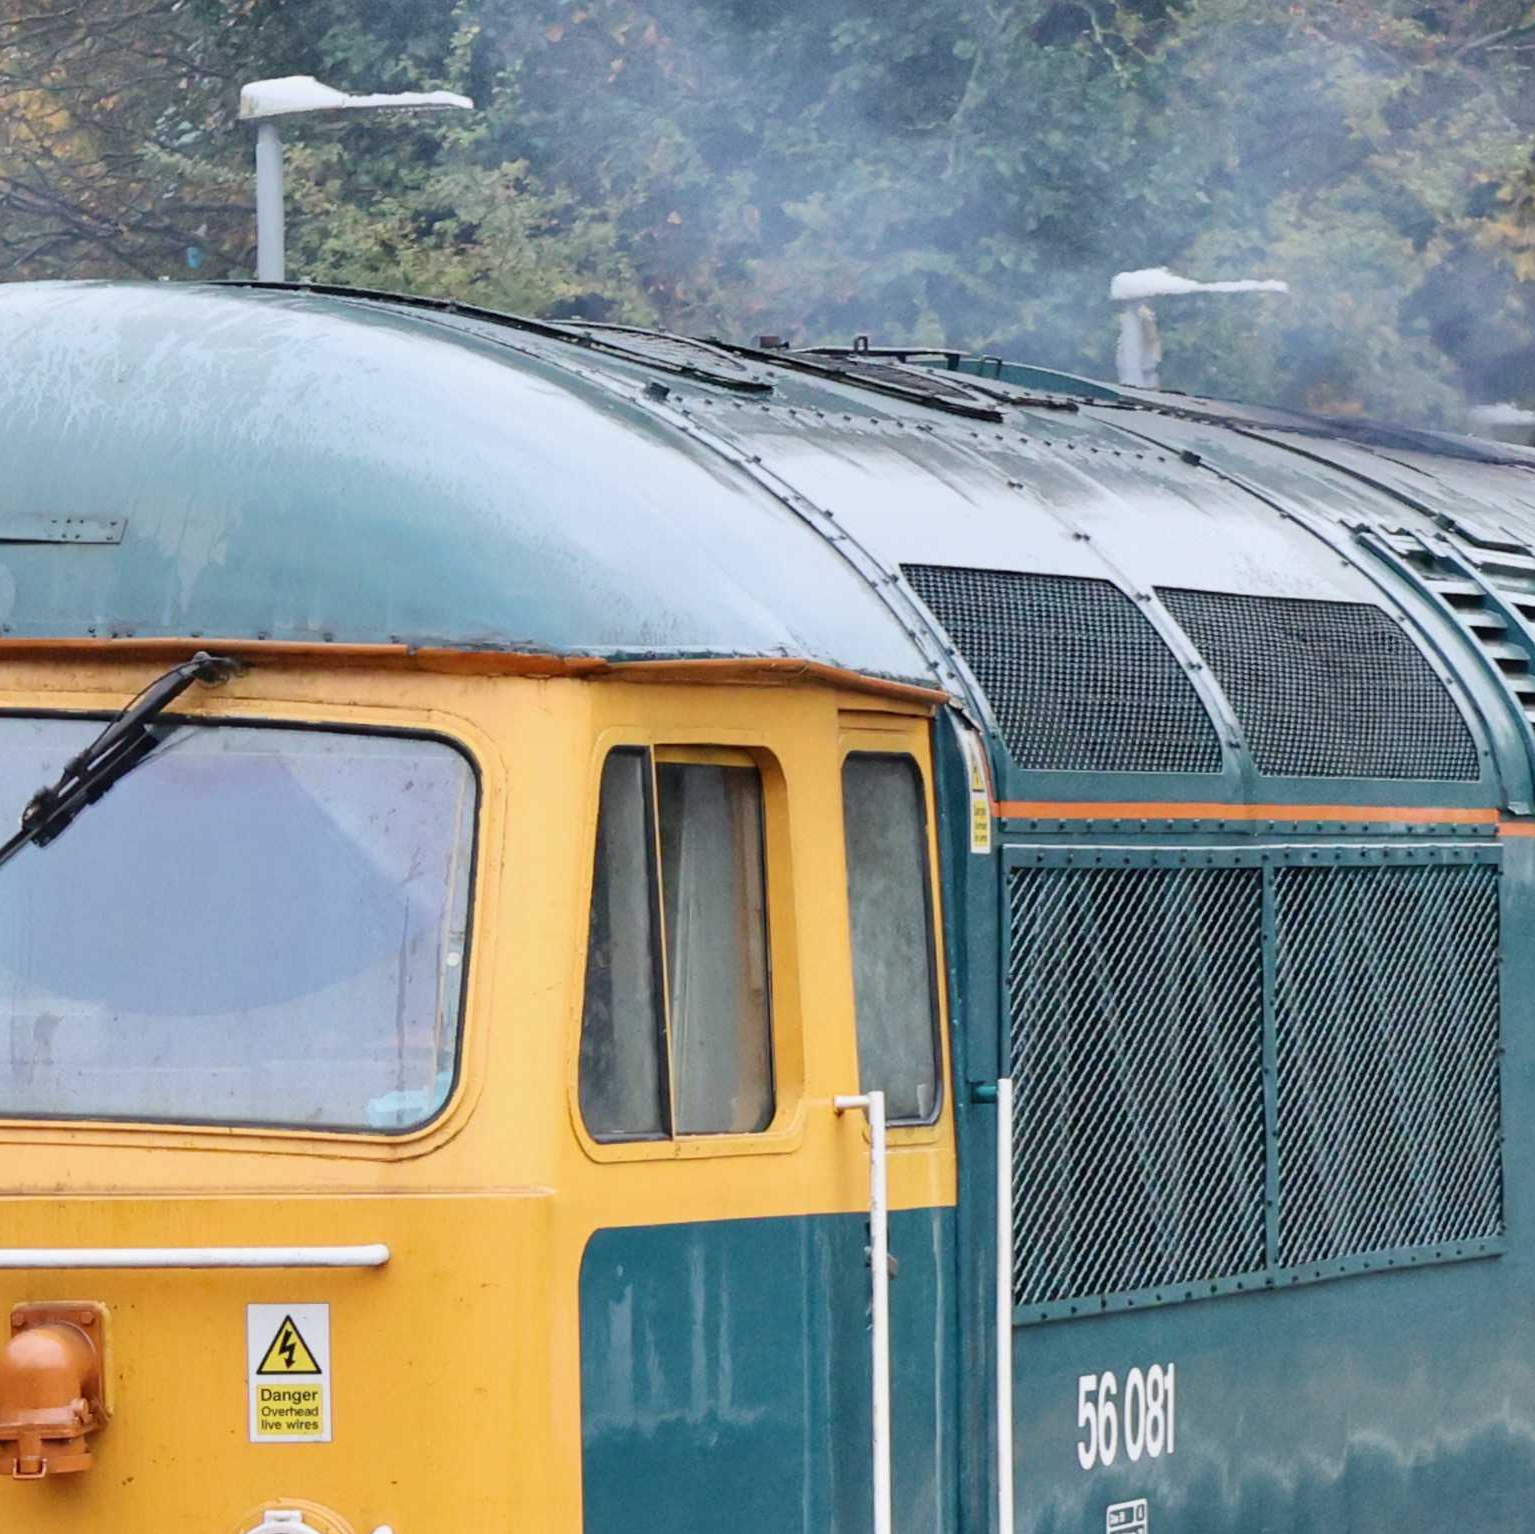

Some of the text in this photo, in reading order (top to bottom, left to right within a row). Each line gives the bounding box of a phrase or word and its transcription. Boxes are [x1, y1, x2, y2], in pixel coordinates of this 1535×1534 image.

[260, 1388, 318, 1405] Danger
[261, 1405, 319, 1417] Overhead
[1077, 1362, 1175, 1470] 56 081
[261, 1419, 319, 1430] live wires
